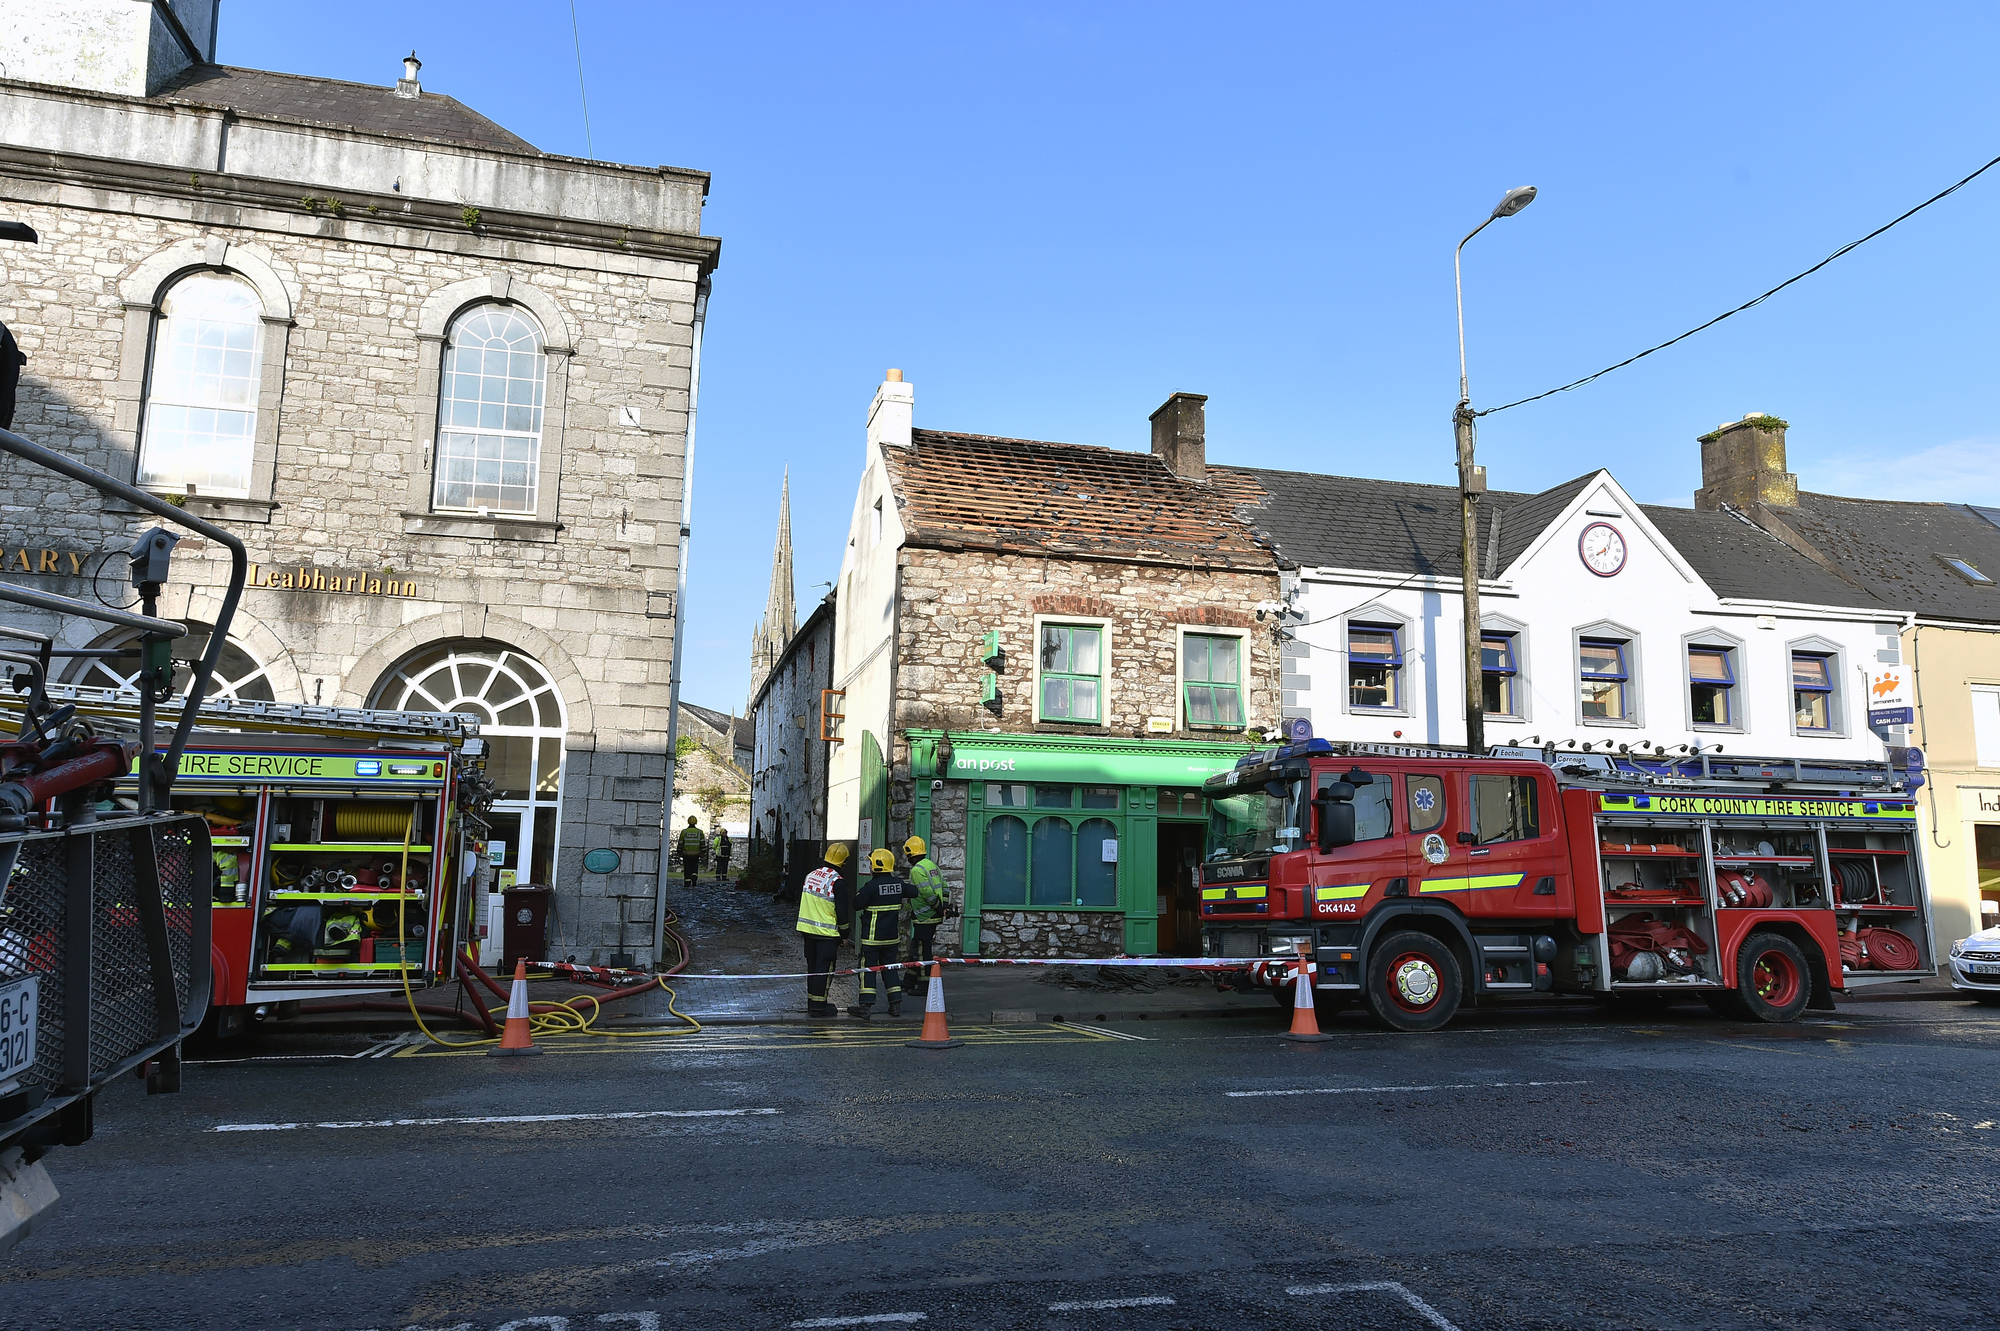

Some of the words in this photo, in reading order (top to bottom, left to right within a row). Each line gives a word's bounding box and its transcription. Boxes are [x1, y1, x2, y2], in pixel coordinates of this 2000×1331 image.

[0, 548, 90, 575] ARY
[248, 563, 417, 597] Leabharlann
[228, 756, 323, 775] SERVICE
[956, 758, 977, 770] an
[980, 758, 1016, 772] post
[1659, 797, 1698, 813] CORK
[1704, 798, 1759, 815] COUNTY
[1765, 800, 1794, 816] FIRE
[1799, 801, 1855, 817] SERVICE
[812, 870, 828, 879] FIRE
[1216, 866, 1244, 878] SCANIA
[882, 884, 901, 894] FIRE
[1318, 904, 1356, 913] CK41A2
